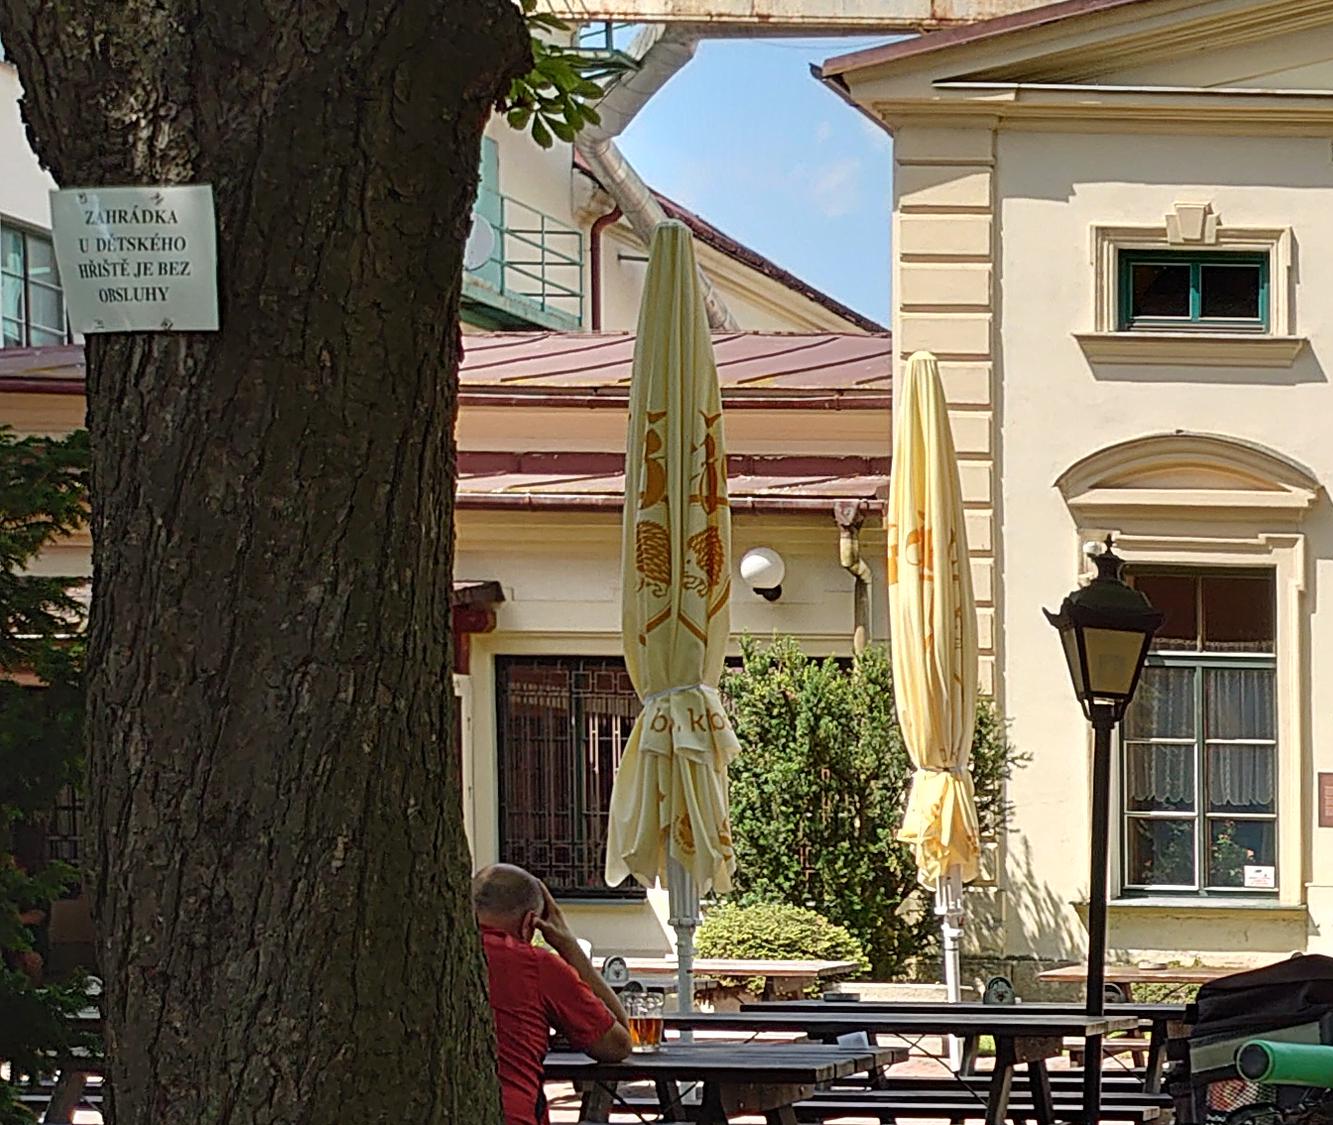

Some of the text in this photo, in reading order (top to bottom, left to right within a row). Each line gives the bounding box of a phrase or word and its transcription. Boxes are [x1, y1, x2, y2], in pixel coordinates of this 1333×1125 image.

[85, 205, 178, 225] ZAHRÁDKA
[79, 233, 186, 253] U DĚTSKÉHO
[78, 258, 191, 279] HŘIŠTĚ JE BEZ
[99, 287, 169, 303] OBSLUHY
